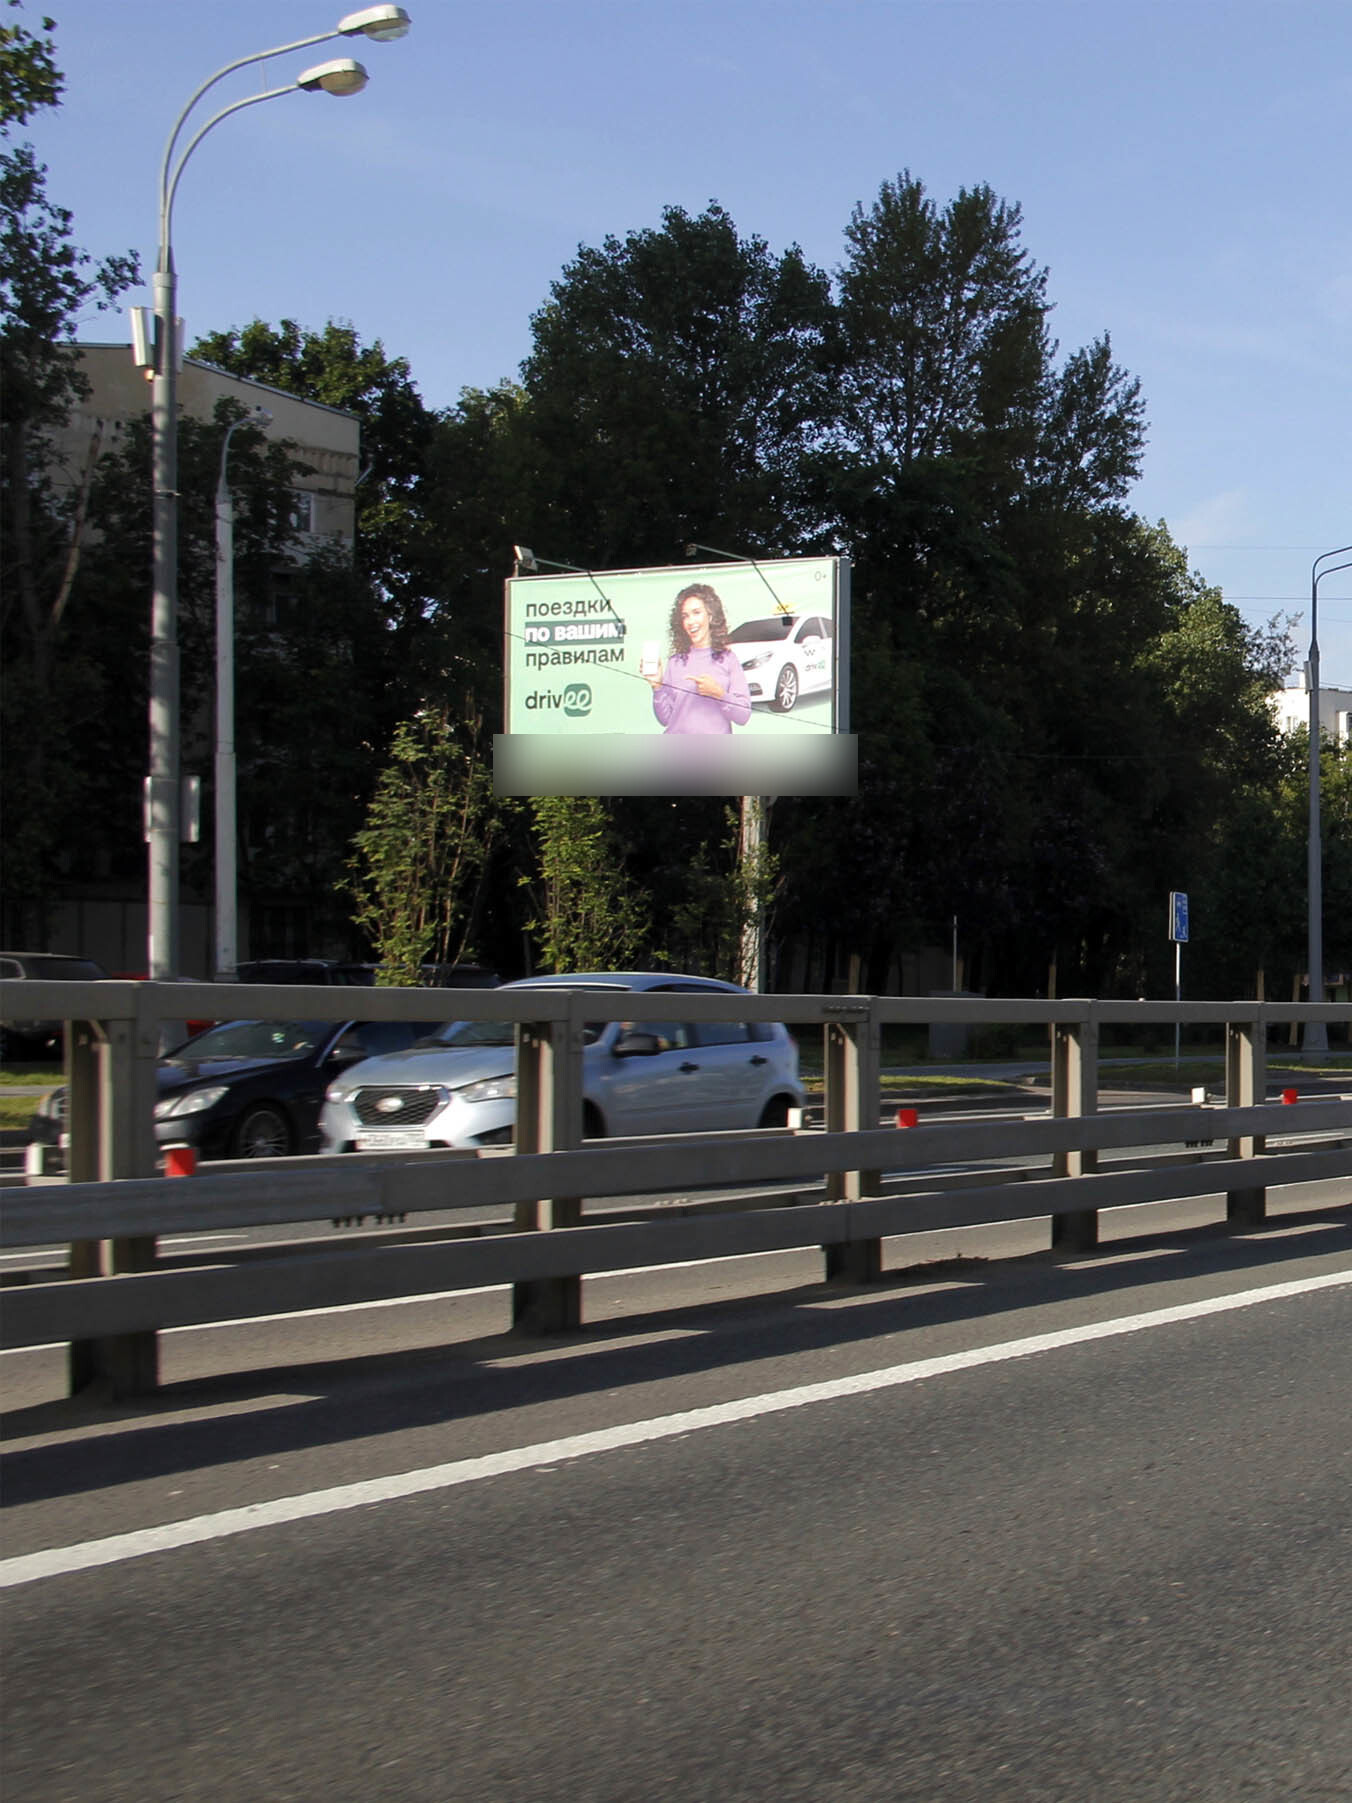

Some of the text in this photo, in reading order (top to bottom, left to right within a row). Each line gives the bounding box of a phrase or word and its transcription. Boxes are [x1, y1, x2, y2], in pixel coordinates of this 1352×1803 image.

[526, 599, 612, 618] поездки
[525, 622, 624, 642] по вашим
[526, 648, 625, 671] правилам
[525, 685, 592, 713] drivee
